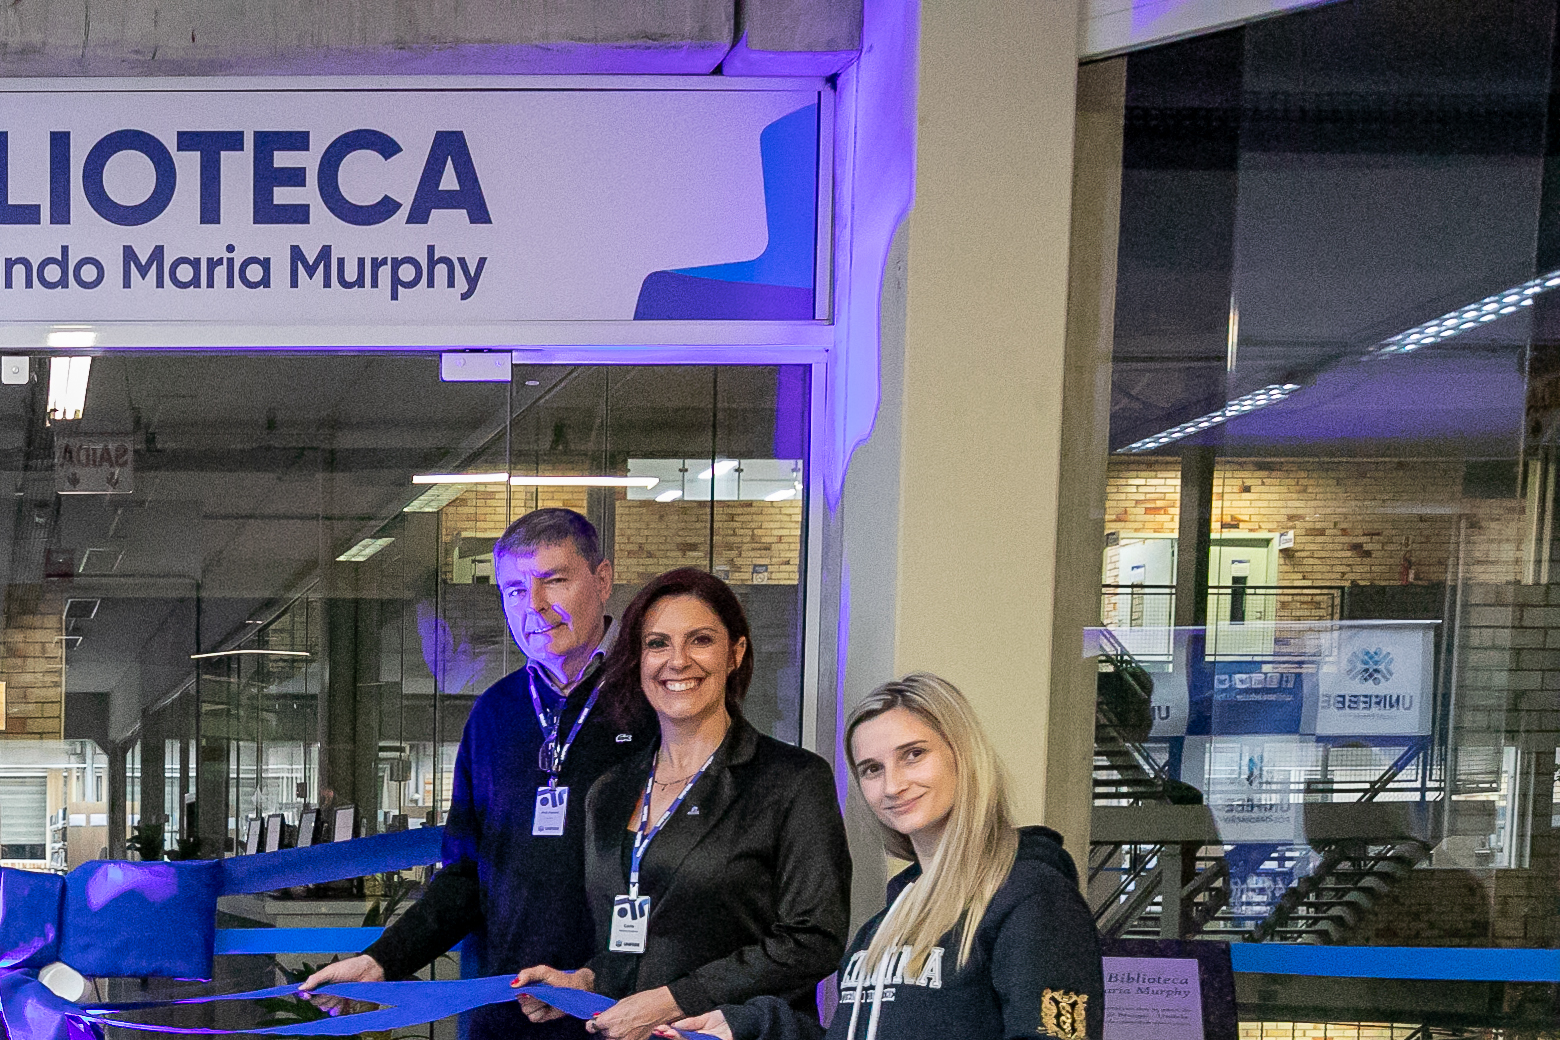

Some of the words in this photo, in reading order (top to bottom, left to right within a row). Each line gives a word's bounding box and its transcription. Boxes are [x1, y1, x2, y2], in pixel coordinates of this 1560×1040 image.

[123, 243, 271, 290] Maria
[290, 243, 488, 302] Murphy
[1107, 972, 1189, 985] Biblioteca
[1135, 987, 1191, 998] Murphy
